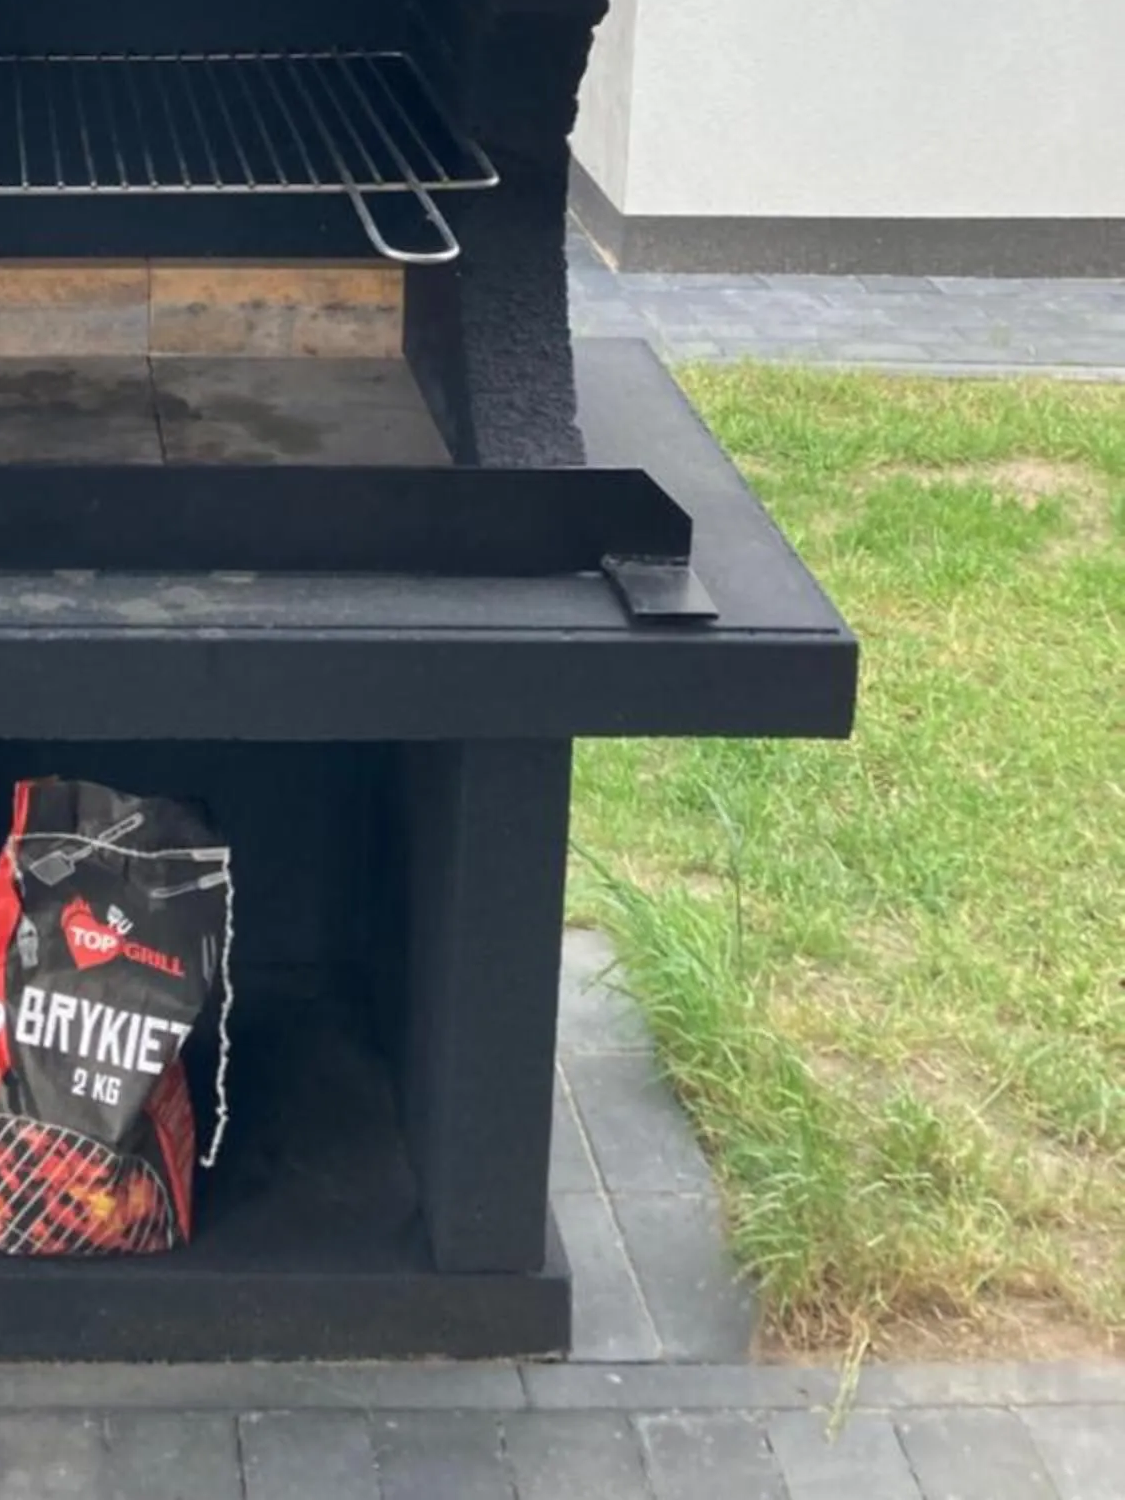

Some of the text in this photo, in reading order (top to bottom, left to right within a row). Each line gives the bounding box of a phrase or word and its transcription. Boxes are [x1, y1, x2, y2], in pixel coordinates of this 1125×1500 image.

[70, 926, 186, 978] TOP GRILL
[71, 1067, 122, 1106] 2 KG
